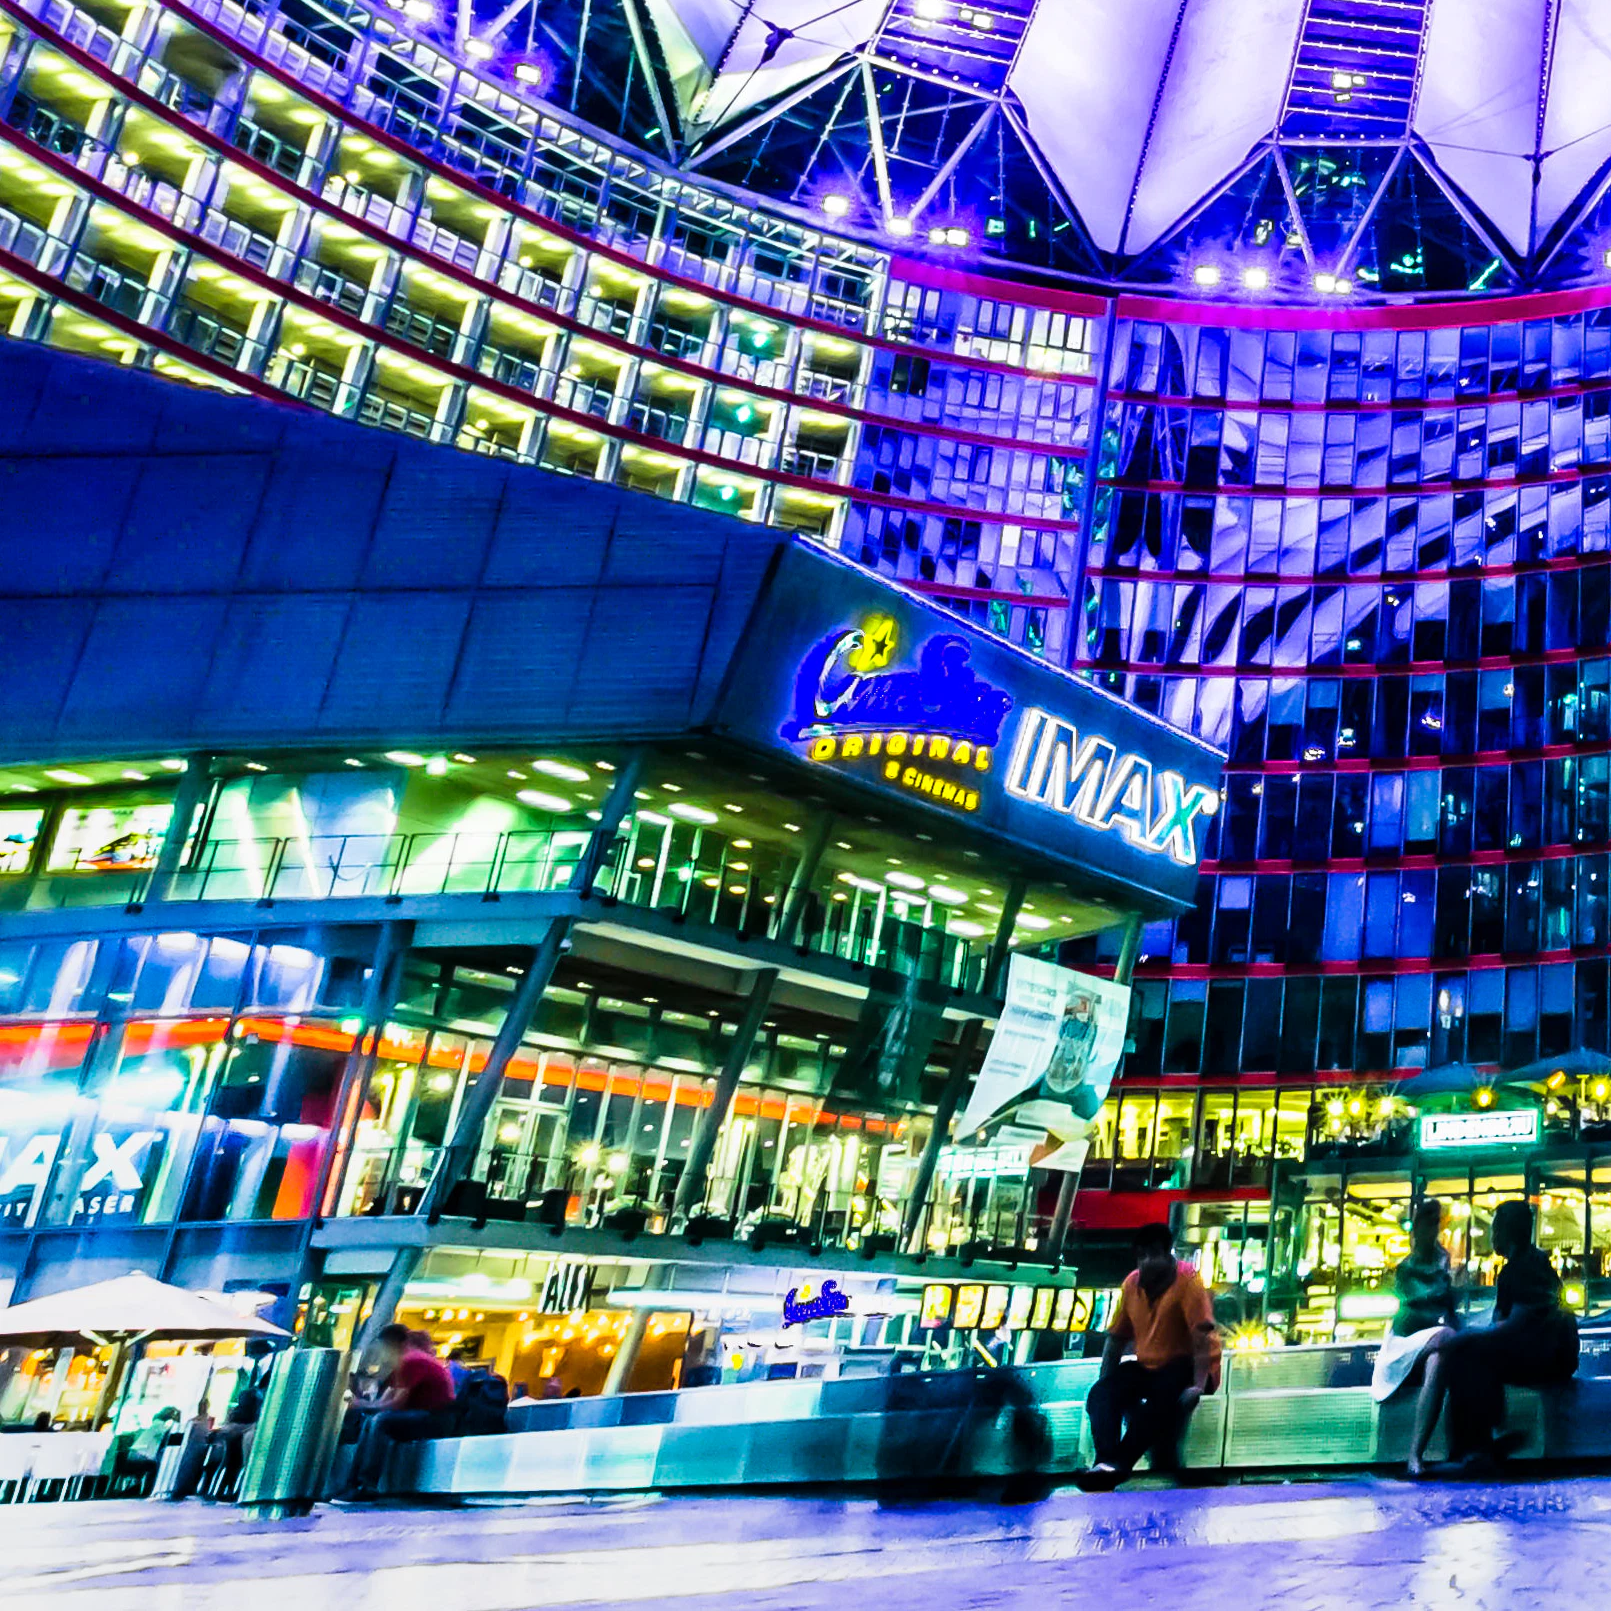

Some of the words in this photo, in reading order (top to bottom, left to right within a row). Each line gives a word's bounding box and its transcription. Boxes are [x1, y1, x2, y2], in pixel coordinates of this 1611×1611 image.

[811, 732, 990, 771] ORIGINAL
[1006, 706, 1198, 866] IMAX
[0, 1131, 154, 1196] AX
